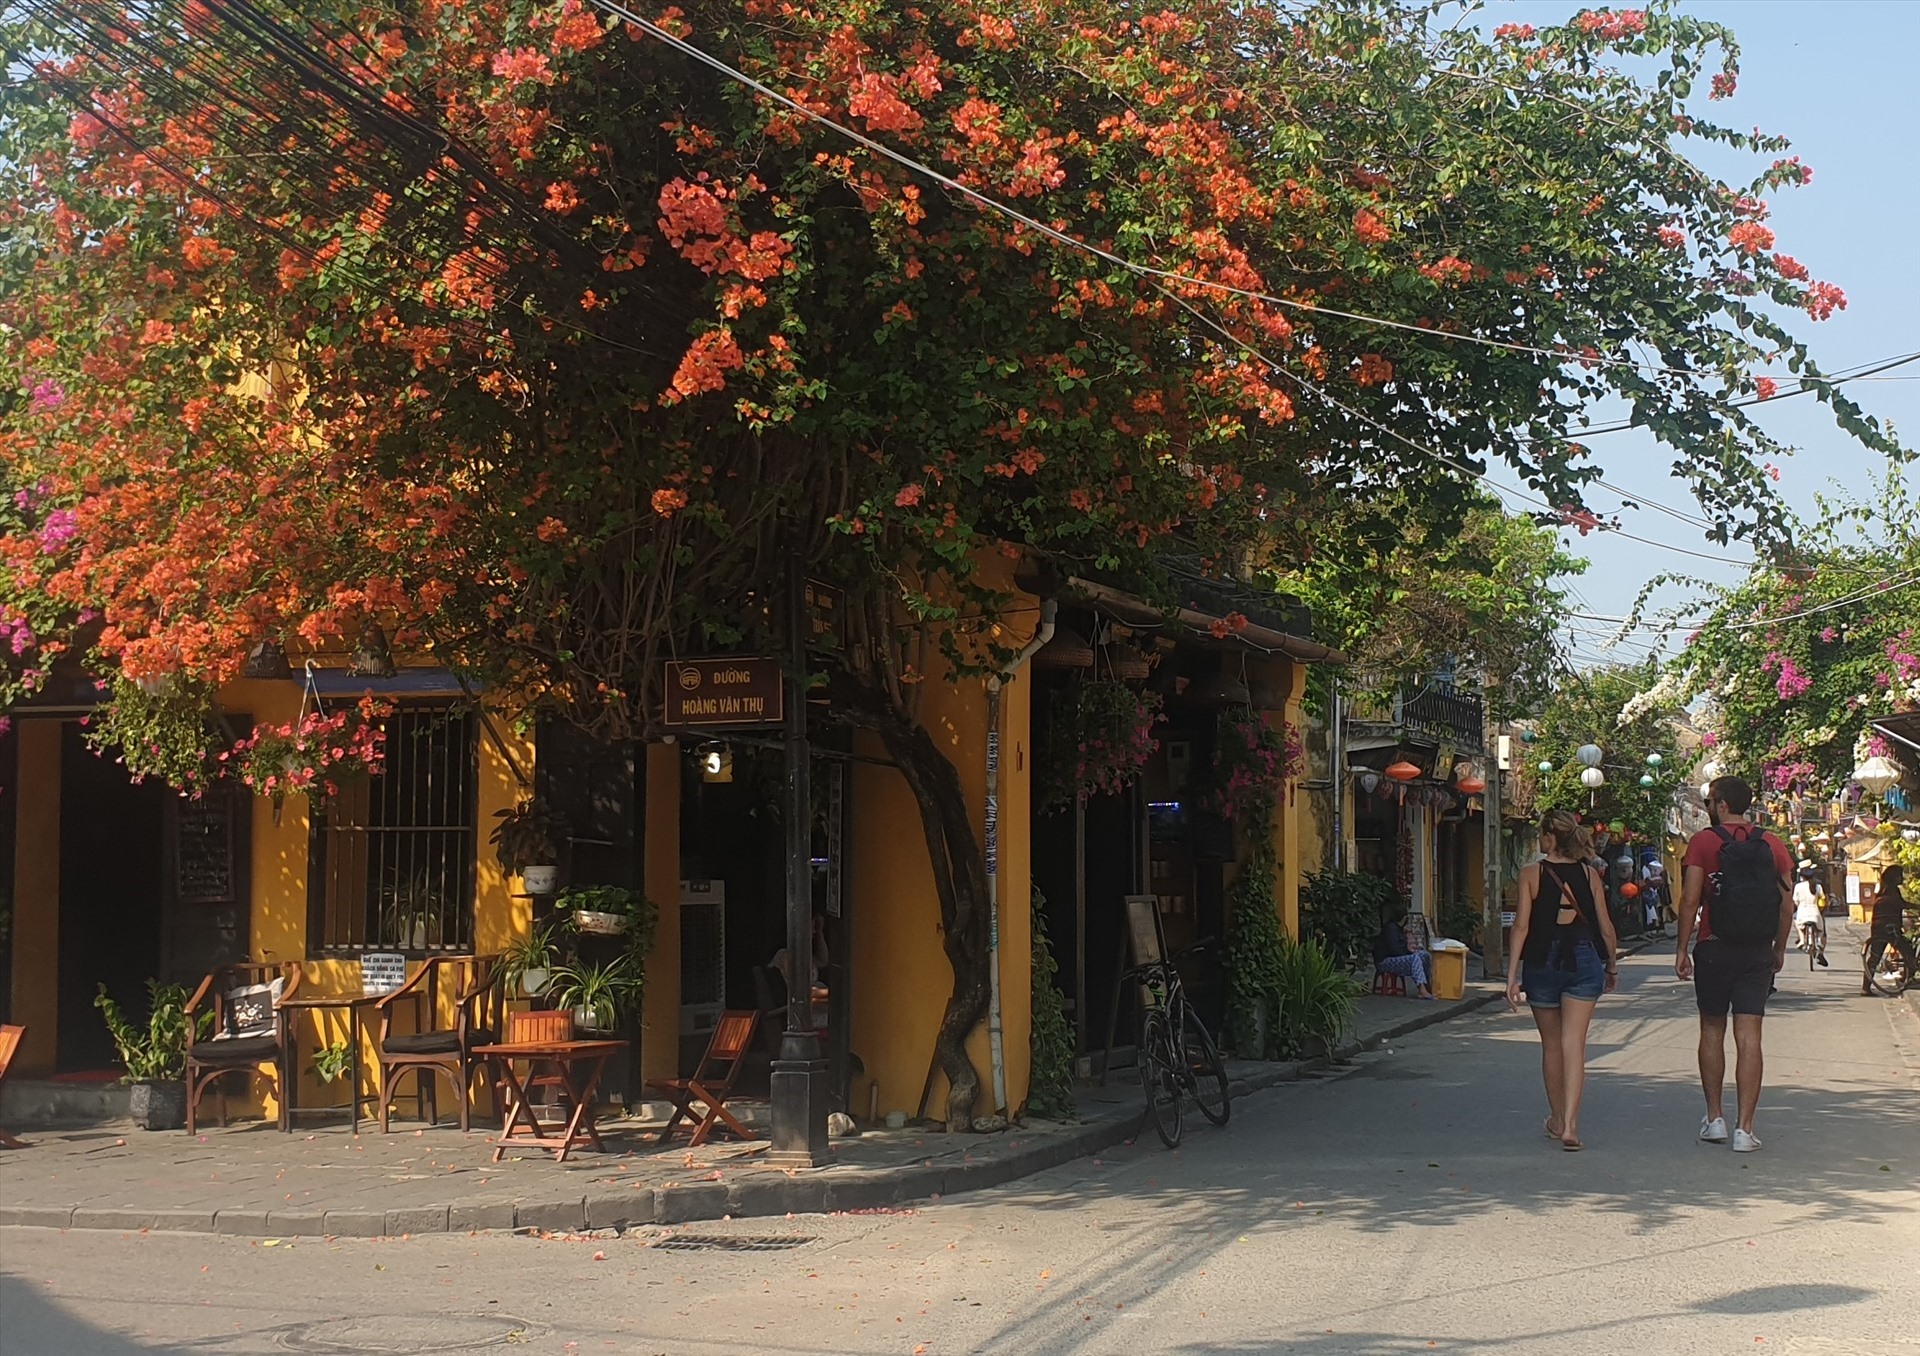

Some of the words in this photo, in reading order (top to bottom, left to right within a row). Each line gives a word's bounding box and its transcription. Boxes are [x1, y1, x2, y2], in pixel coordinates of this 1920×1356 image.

[682, 696, 717, 715] HOÀNG
[720, 696, 740, 714] VĂN
[743, 696, 764, 716] THỤ
